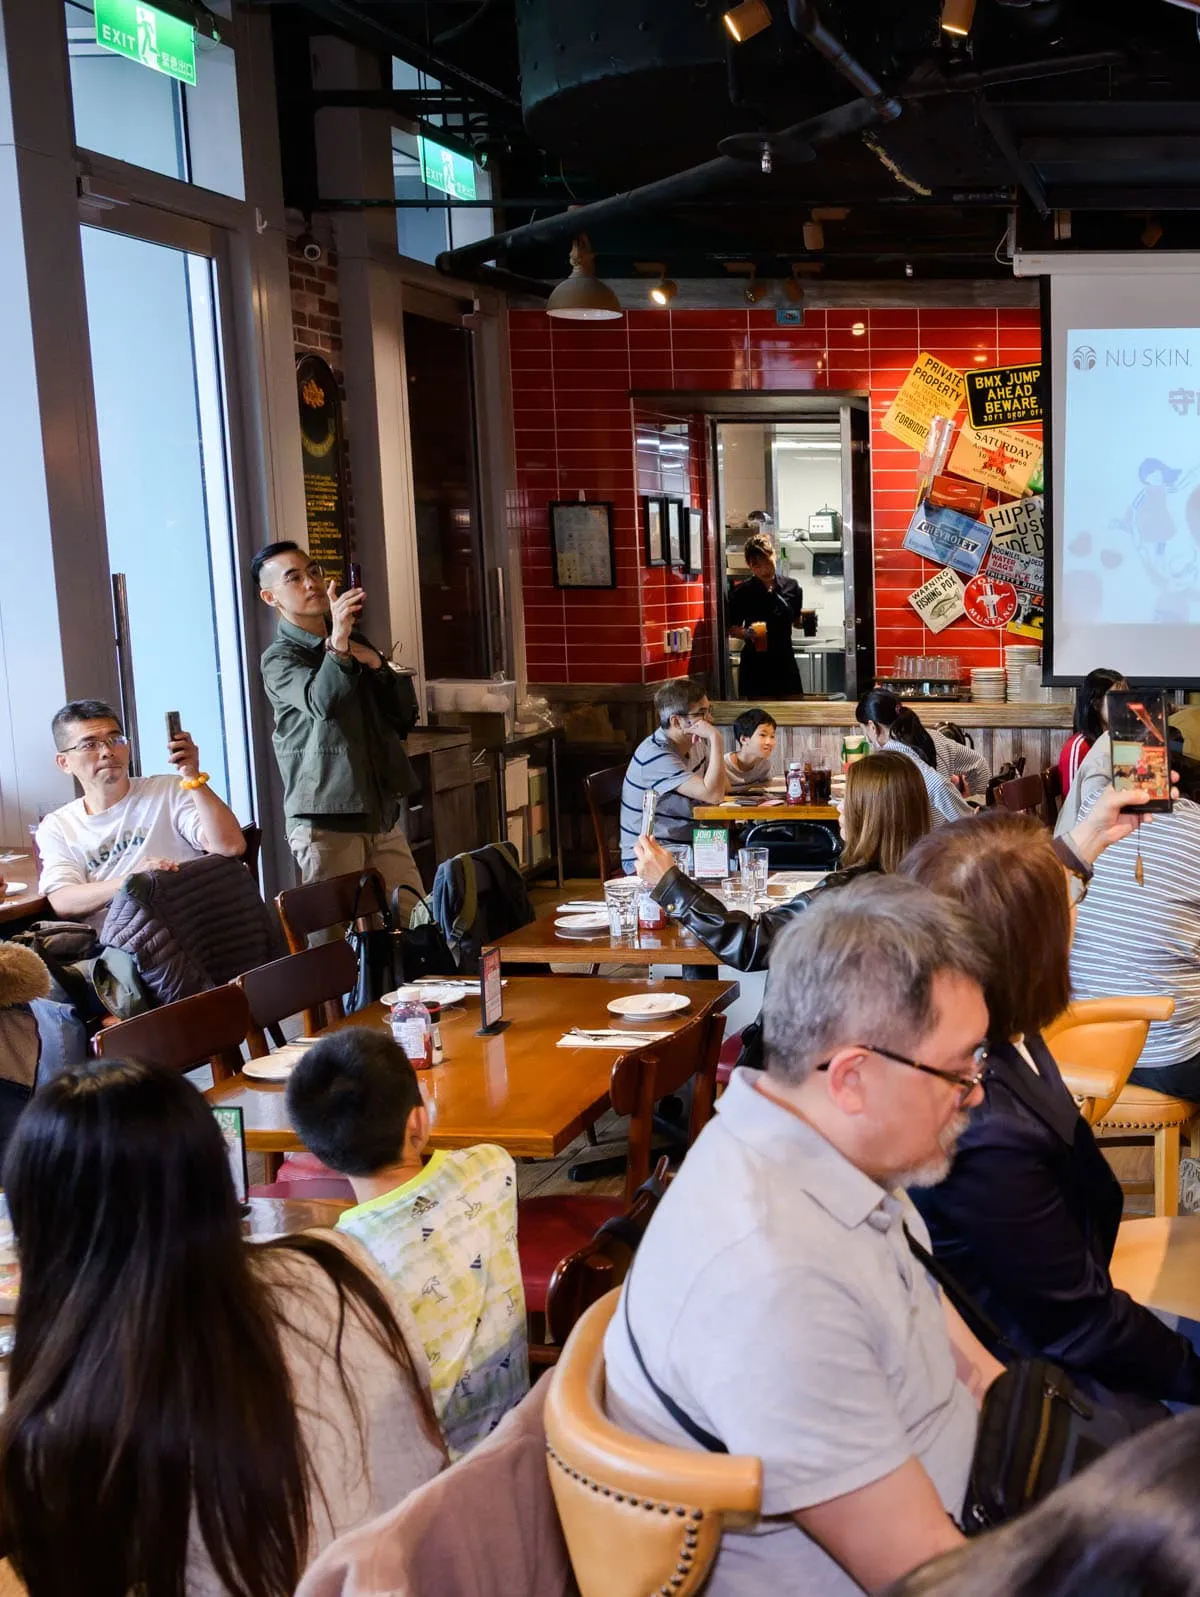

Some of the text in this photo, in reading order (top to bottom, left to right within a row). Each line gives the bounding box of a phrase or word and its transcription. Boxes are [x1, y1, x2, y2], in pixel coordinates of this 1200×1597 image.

[102, 24, 135, 52] EXIT
[427, 166, 444, 183] EXIT
[1106, 348, 1190, 367] NU SKIN
[913, 366, 962, 401] PROPERTY
[924, 358, 965, 388] PRIVATE
[975, 370, 1041, 389] BMX JUMP
[987, 384, 1033, 400] AHEAD
[985, 397, 1039, 413] BEWARE
[974, 431, 1033, 460] SATURDAY
[988, 502, 1037, 528] HIPP
[922, 522, 975, 551] CHEVROLET
[991, 552, 1016, 566] WATER
[992, 560, 1014, 572] BAGS
[912, 571, 949, 600] WARNING
[915, 575, 958, 610] FISHING POX
[971, 576, 1004, 590] FORD
[969, 602, 1014, 625] MUSTANG
